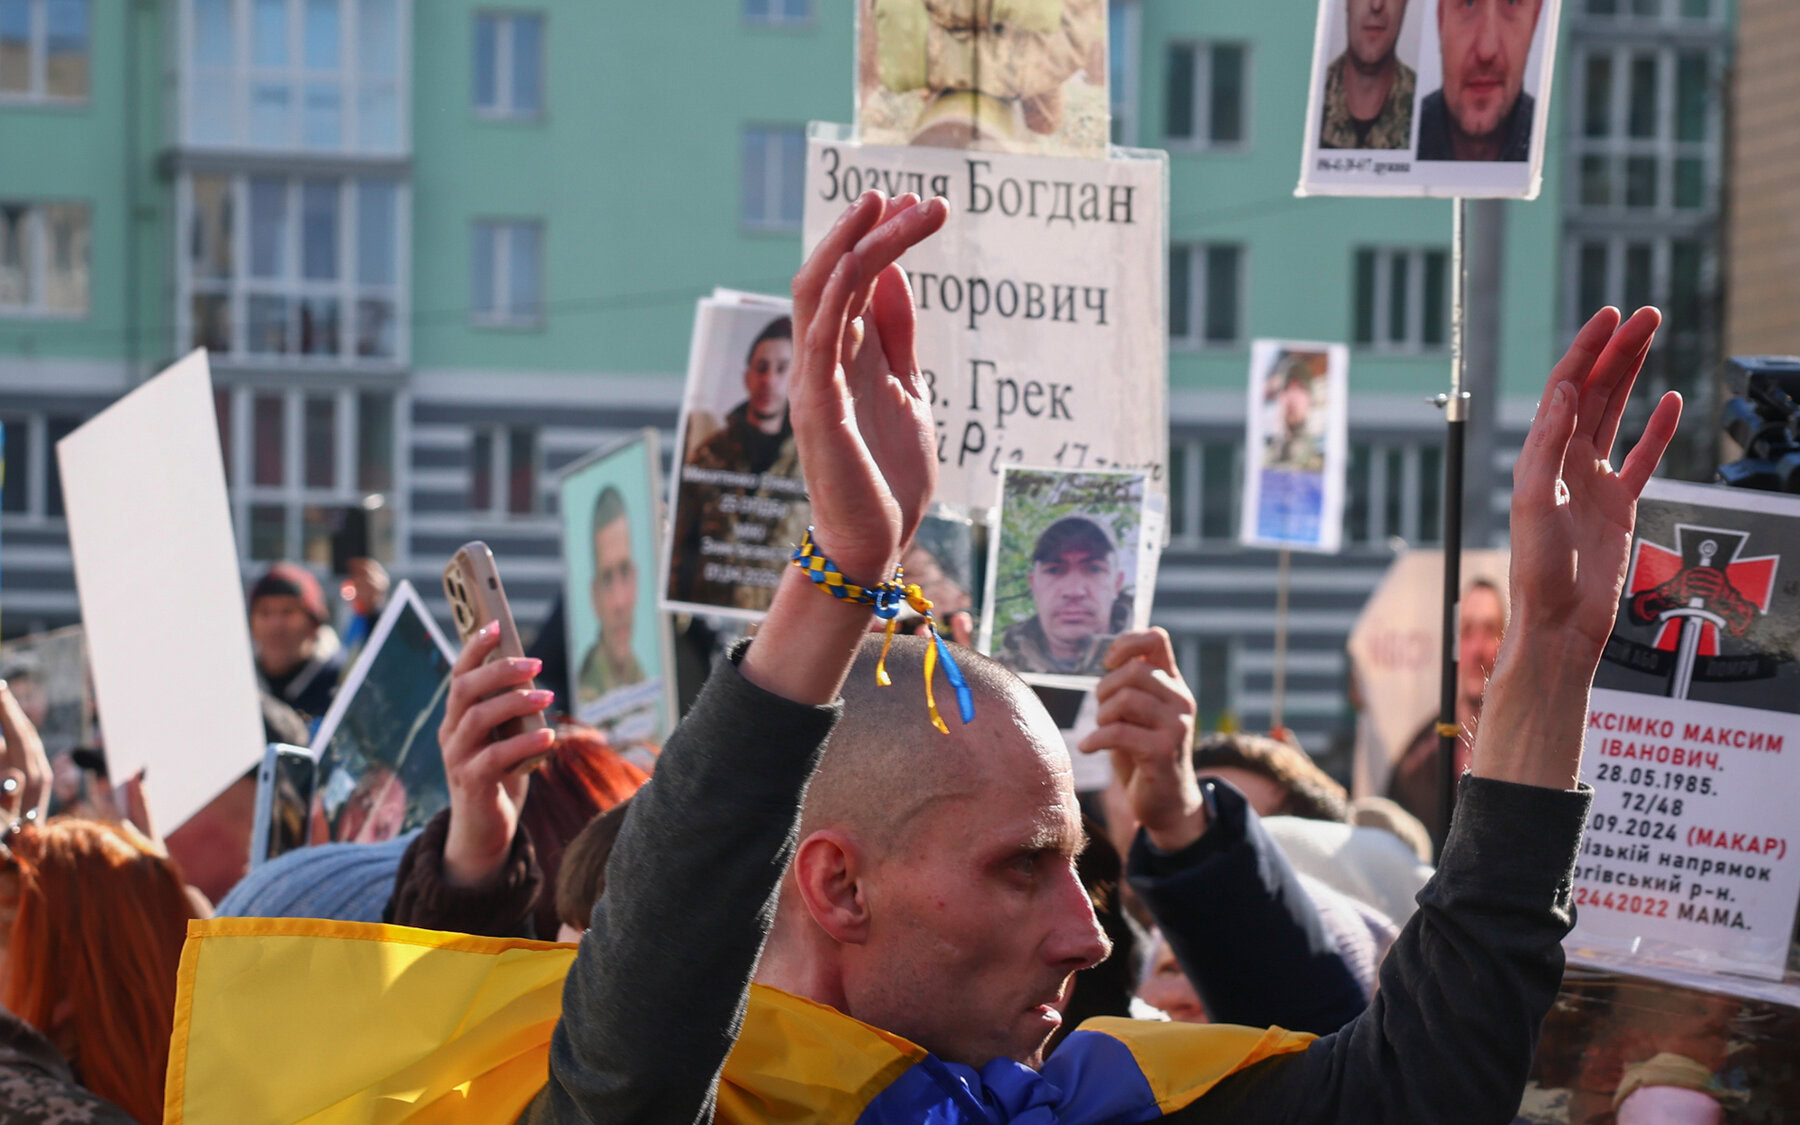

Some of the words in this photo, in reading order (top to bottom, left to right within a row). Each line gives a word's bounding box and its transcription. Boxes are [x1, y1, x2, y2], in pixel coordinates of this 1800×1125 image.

[966, 159, 1137, 226] Богдан
[906, 271, 1110, 330] горович
[968, 358, 1074, 430] Грек
[1588, 710, 1675, 739] КСІМКО
[1682, 722, 1785, 754] МАКСИМ
[1600, 737, 1725, 772] ІВАНОВИЧ.
[1596, 763, 1718, 797] 28.05.1985.
[1620, 792, 1684, 817] 72/48
[1586, 813, 1678, 842] .09.2024
[1686, 825, 1787, 860] (МАКАР)
[1580, 838, 1651, 864] ізькій
[1657, 850, 1772, 882] напрямок
[1574, 864, 1682, 894] огівський
[1689, 882, 1736, 903] р-н.
[1573, 887, 1670, 919] 2442022
[1677, 902, 1753, 931] МАМА.
